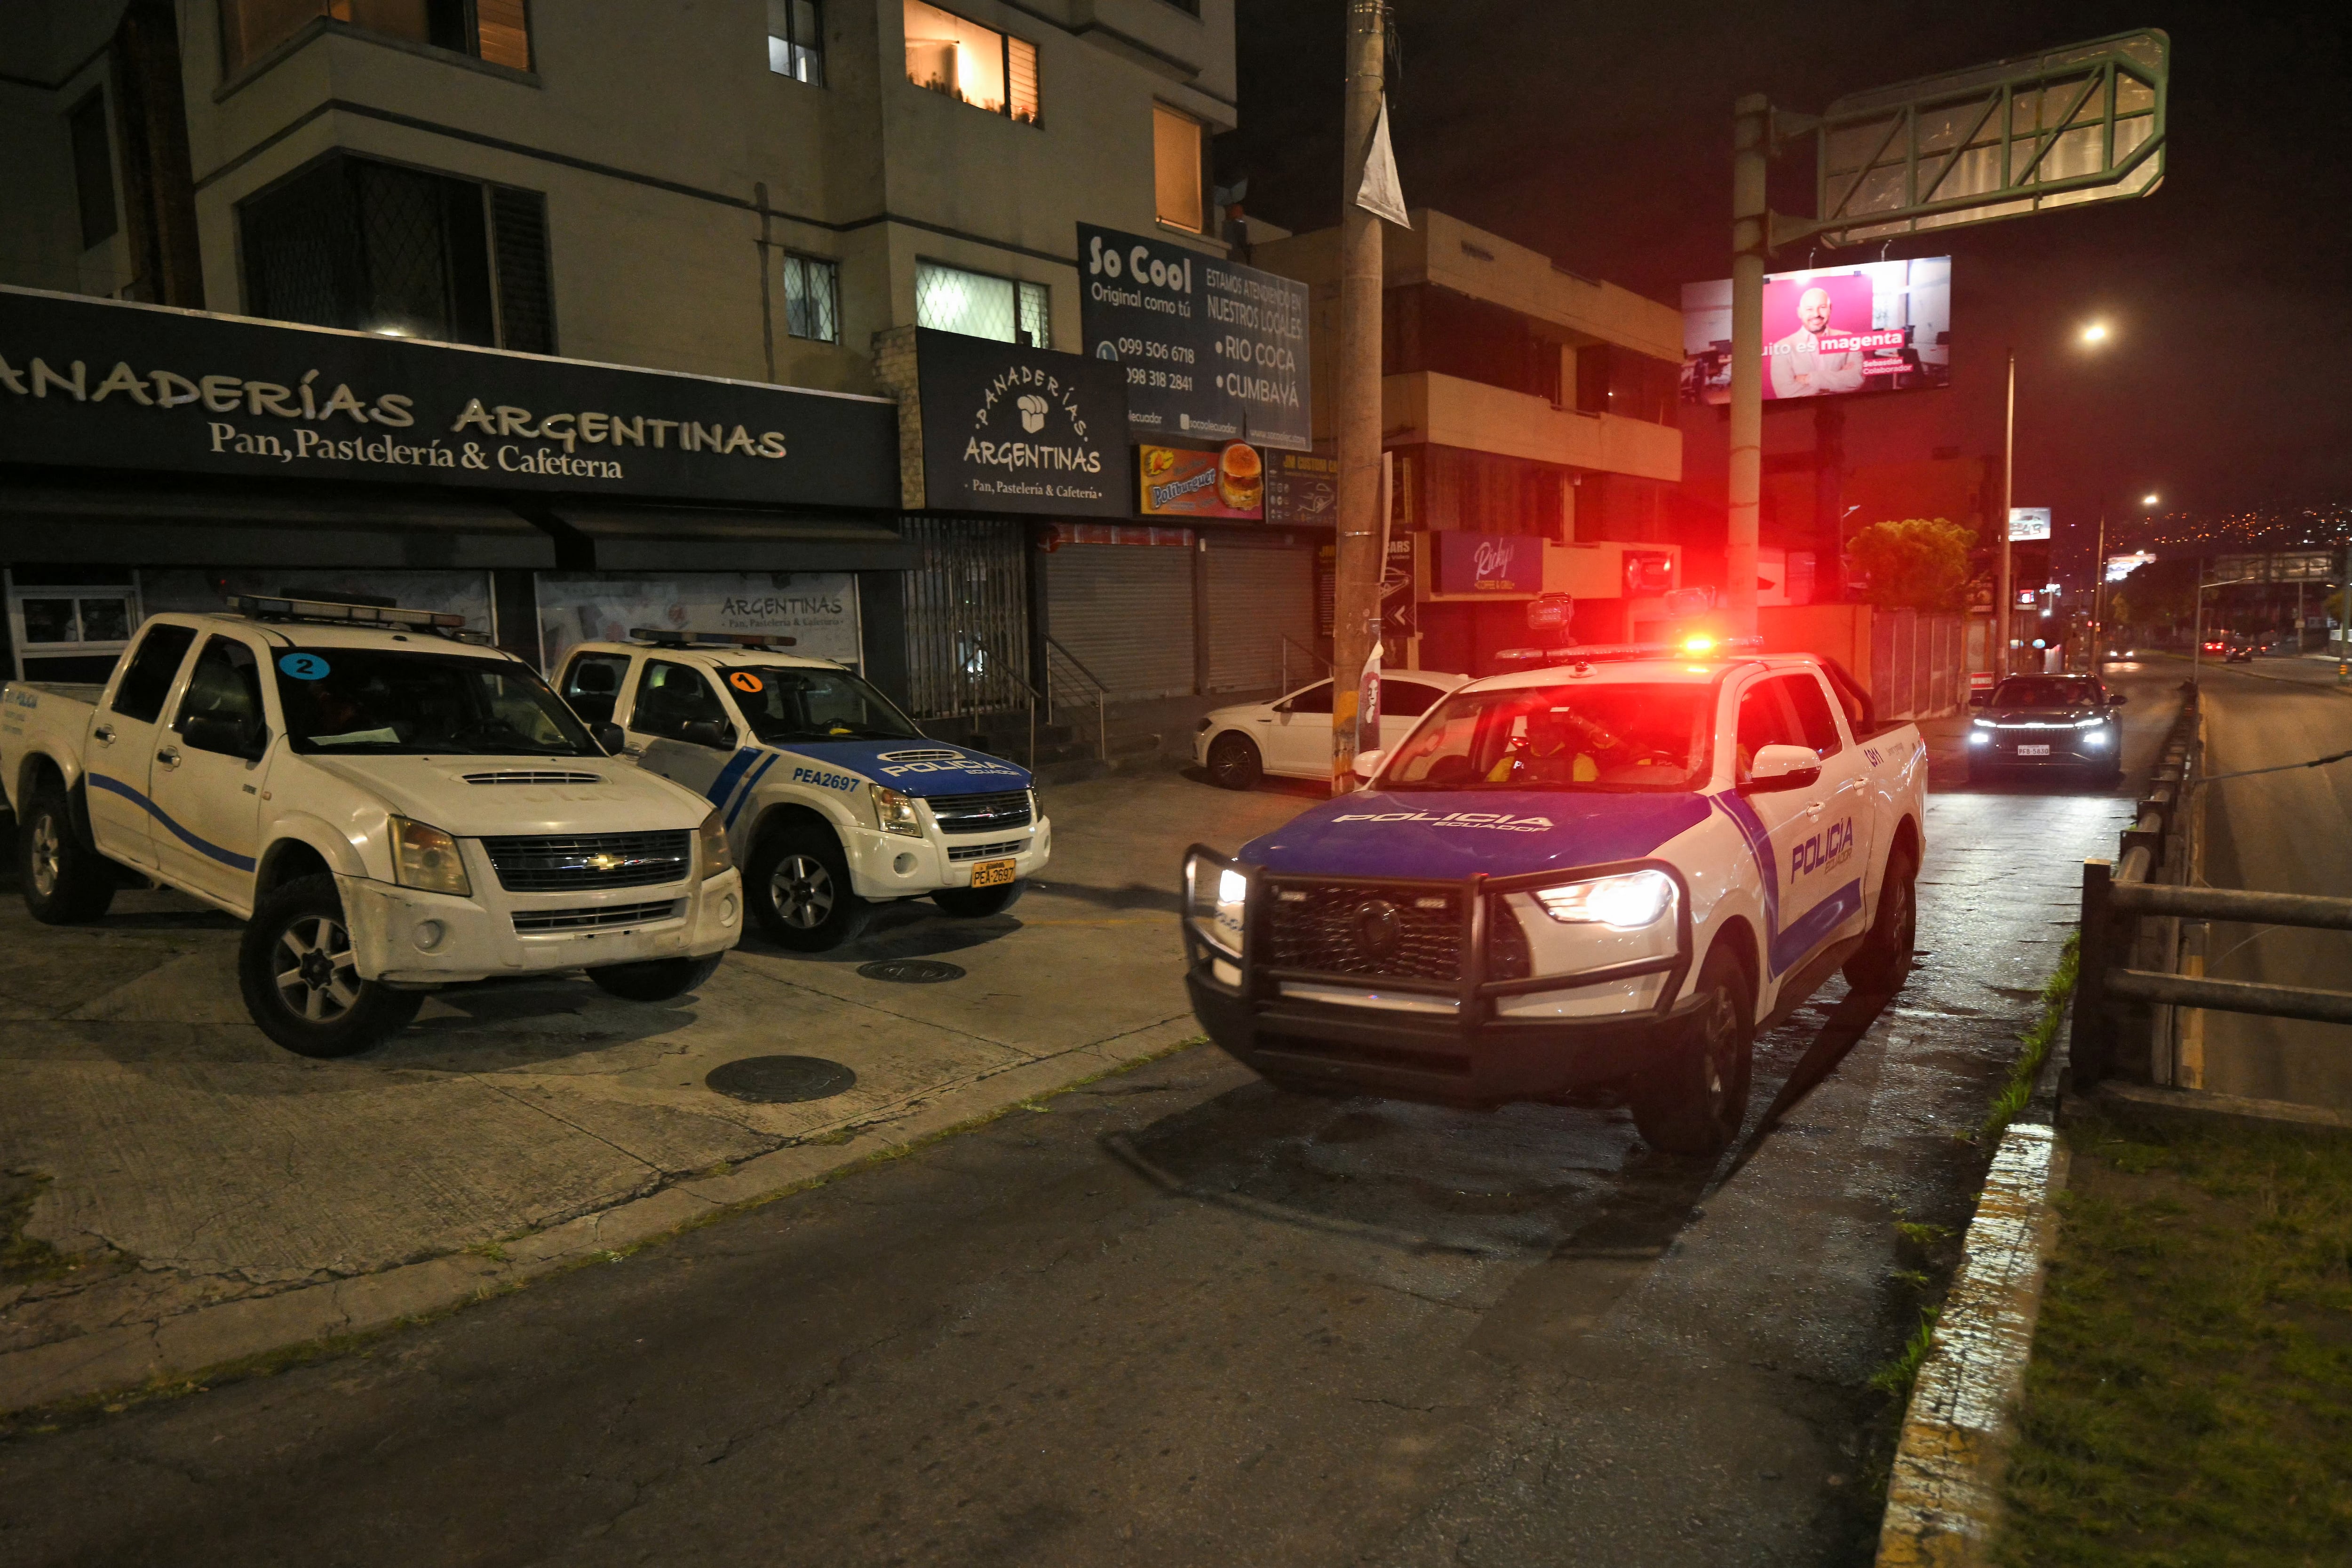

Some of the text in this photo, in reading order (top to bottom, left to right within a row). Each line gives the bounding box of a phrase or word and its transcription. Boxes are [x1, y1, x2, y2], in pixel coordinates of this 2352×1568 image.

[1089, 236, 1192, 294] So Cool
[1206, 268, 1242, 294] ESTAMOS
[1091, 282, 1191, 318] Original como tú
[1207, 294, 1259, 329] NUESTROS
[1118, 337, 1195, 365] 099 506 6718
[1225, 335, 1296, 373] RIO COCA
[1796, 342, 1815, 352] es
[1820, 331, 1902, 351] magenta
[1149, 370, 1167, 387] 318
[1169, 373, 1193, 391] 2841
[1862, 365, 1912, 375] Colaborador
[1226, 373, 1299, 407] CUMBAYÁ
[451, 398, 787, 459] ARGENTINAS
[294, 429, 455, 468] Pastelería
[461, 442, 490, 470] &
[963, 436, 1101, 473] ARGENTINAS
[973, 479, 1098, 499] Pan, Pastelería & Cafetería
[1153, 468, 1216, 508] Poliburguer
[1388, 541, 1410, 553] ARS
[722, 597, 843, 618] ARGENTINAS
[296, 659, 313, 674] 2
[738, 675, 755, 689] 1
[793, 768, 860, 792] PEA2697
[1432, 821, 1551, 832] ECUADOR
